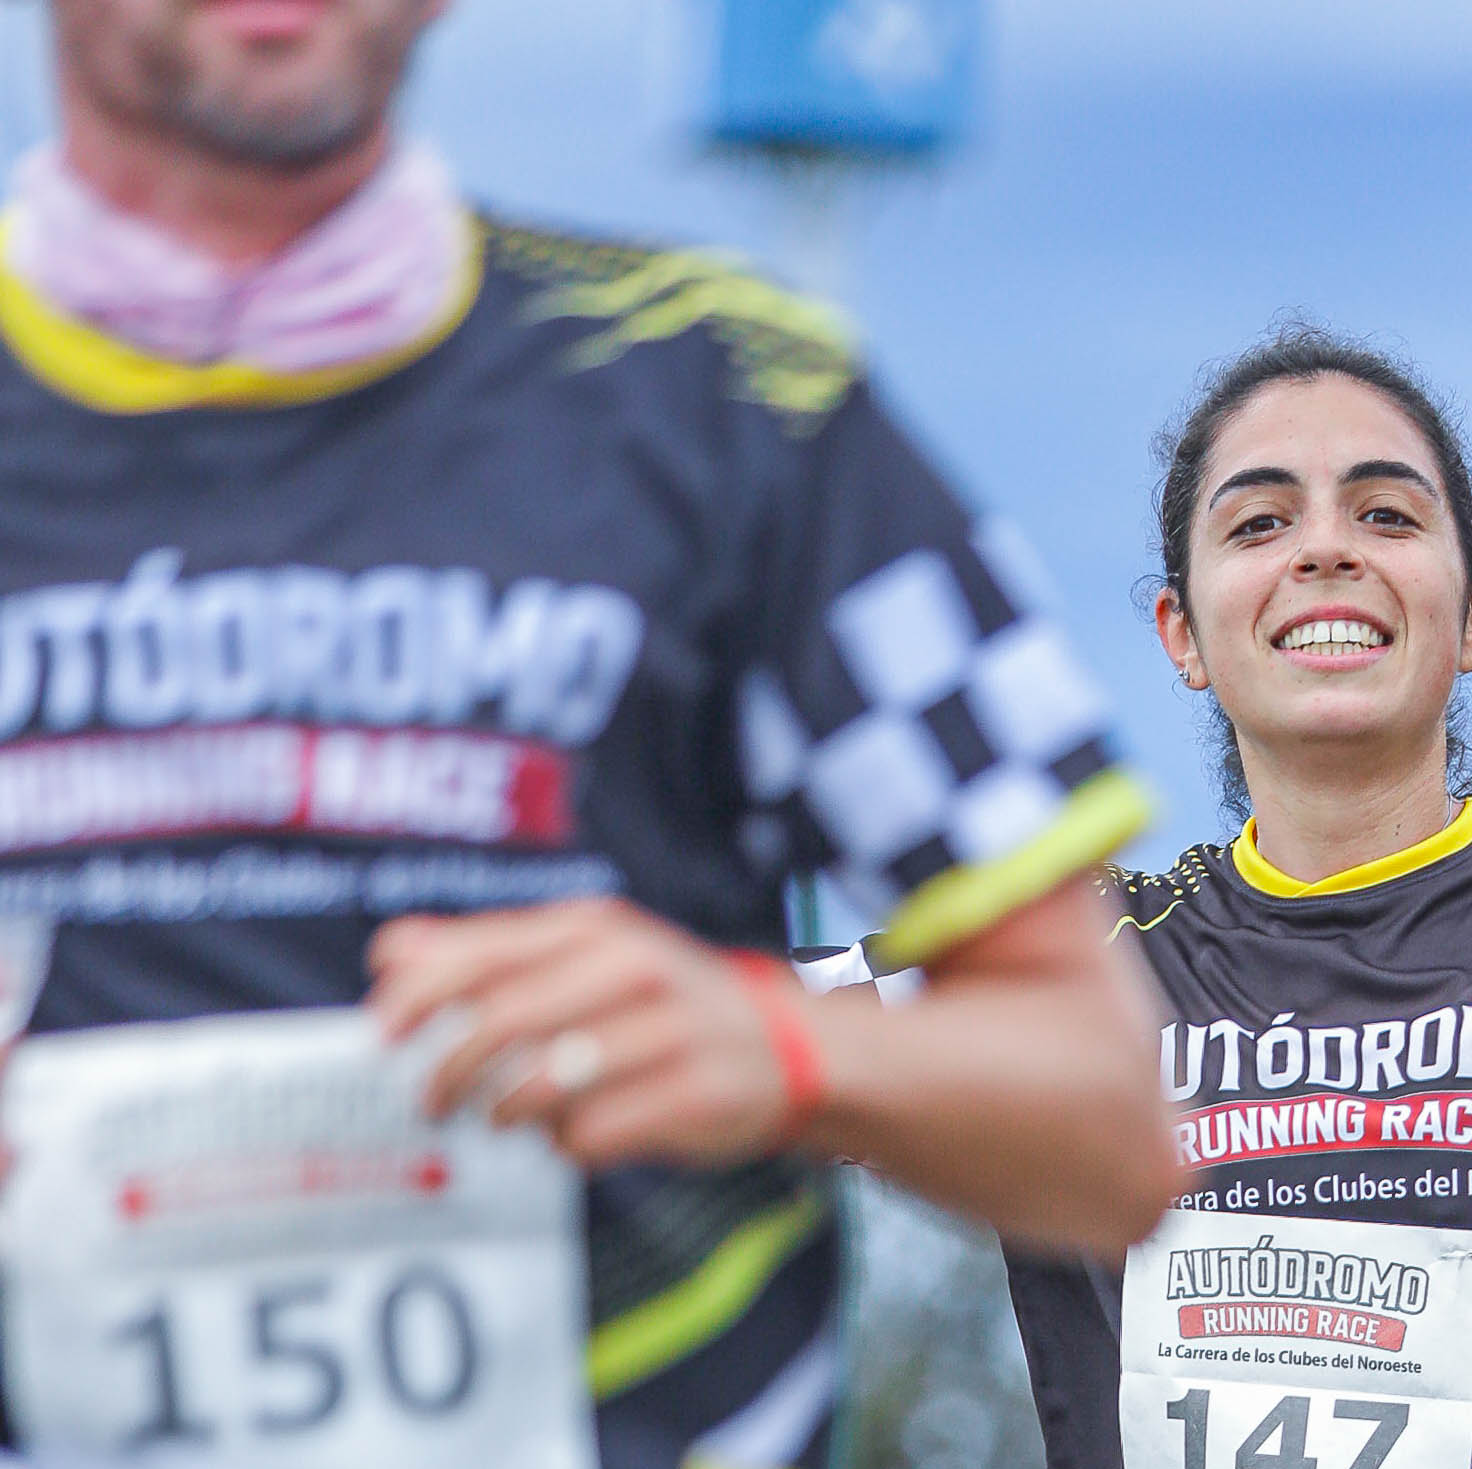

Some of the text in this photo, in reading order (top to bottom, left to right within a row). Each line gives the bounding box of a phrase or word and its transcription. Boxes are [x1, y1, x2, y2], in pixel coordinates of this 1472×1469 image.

[1172, 1098, 1366, 1166] RUNNING
[1225, 1180, 1260, 1209] de
[1267, 1177, 1307, 1207] los
[1313, 1171, 1407, 1204] Clubes
[1414, 1168, 1458, 1198] del
[1166, 1234, 1430, 1315] AUTÓDROMO
[1203, 1304, 1382, 1345] RUNNING RACE
[104, 1265, 480, 1450] 150
[1157, 1341, 1422, 1374] La Carrera de los Clubes del Noroeste
